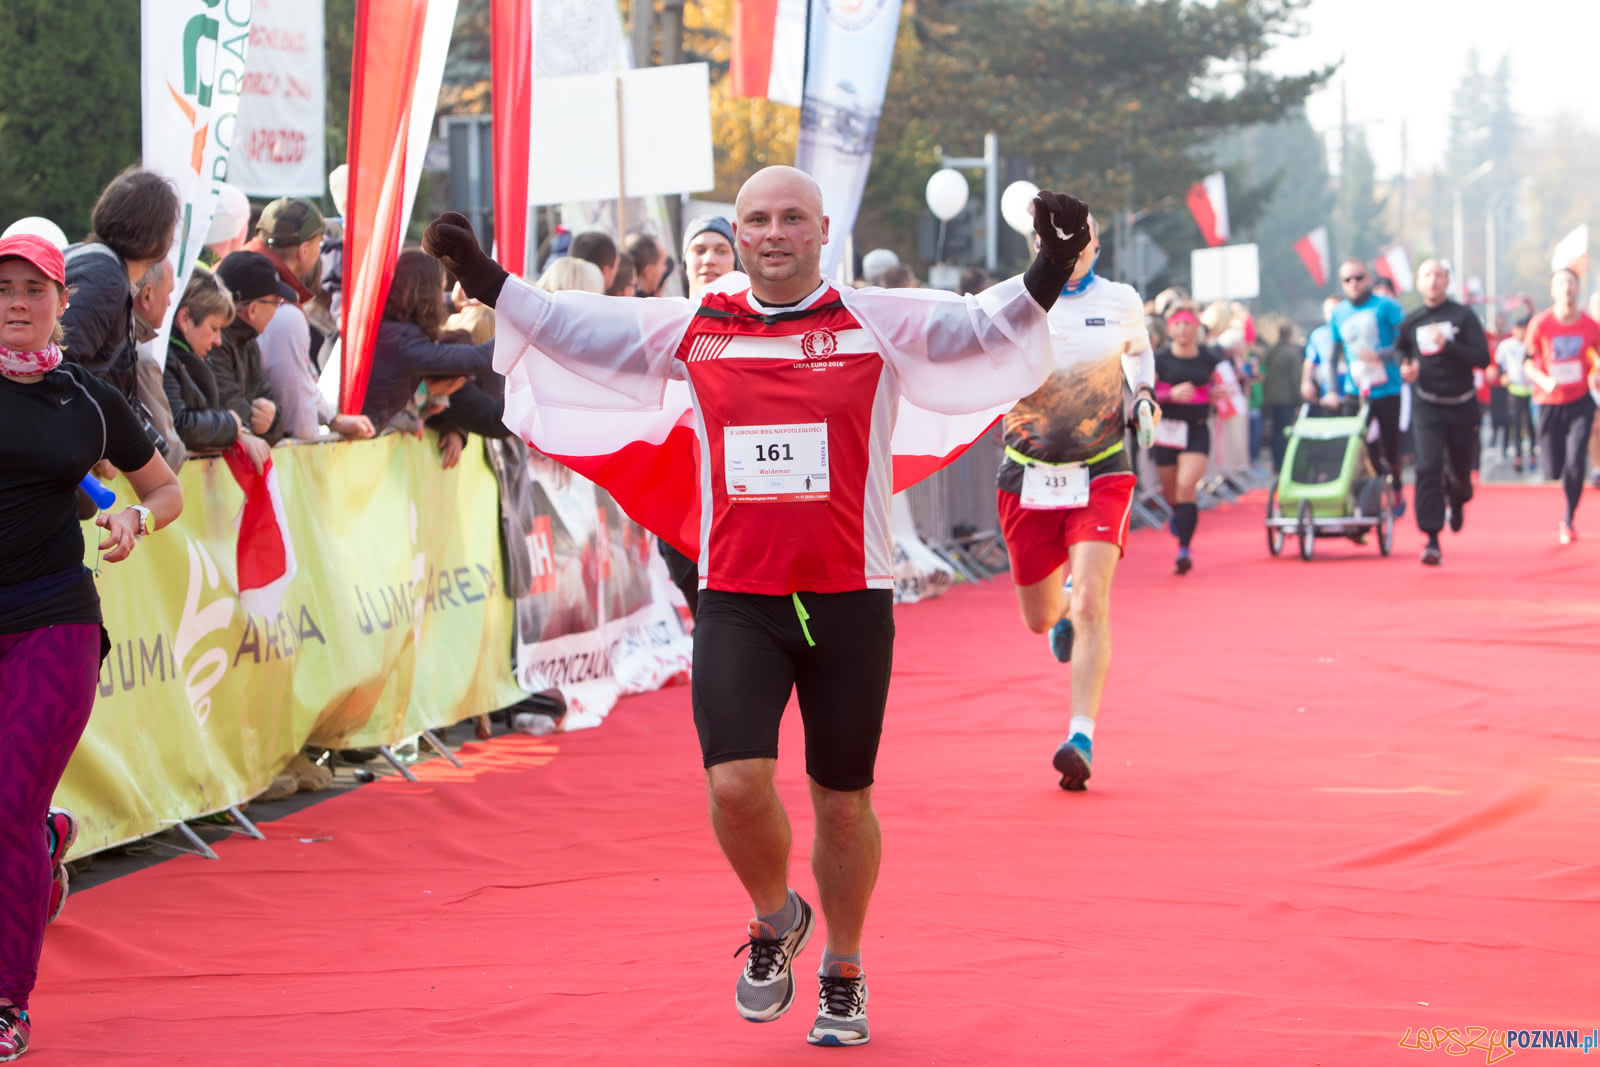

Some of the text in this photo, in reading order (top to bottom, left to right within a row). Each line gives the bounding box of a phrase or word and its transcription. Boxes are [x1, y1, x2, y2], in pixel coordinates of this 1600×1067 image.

[755, 443, 794, 462] 161
[1045, 476, 1067, 488] 233
[232, 603, 326, 668] ARENA
